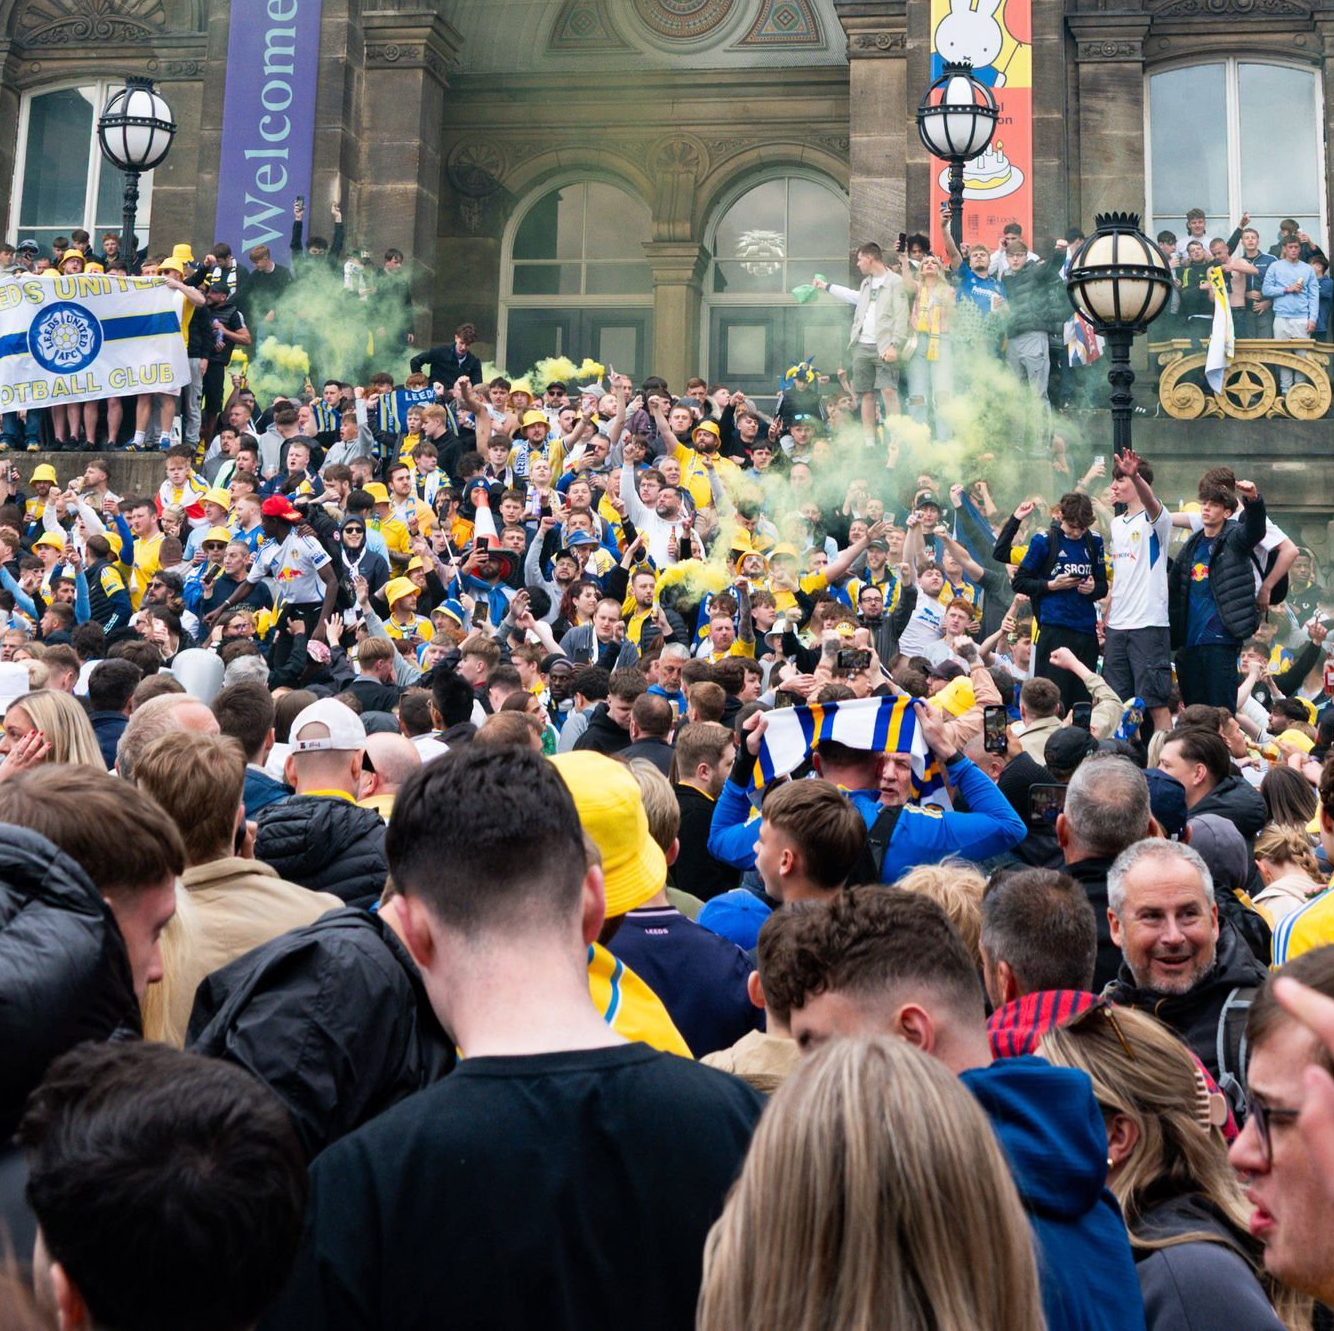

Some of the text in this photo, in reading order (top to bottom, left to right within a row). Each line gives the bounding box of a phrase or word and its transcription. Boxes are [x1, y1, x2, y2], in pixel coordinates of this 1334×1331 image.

[53, 274, 167, 300] UNITE
[44, 315, 88, 350] LEEDS UNITED
[58, 350, 78, 360] AFC
[108, 362, 175, 388] CLUB
[405, 389, 435, 401] LEED
